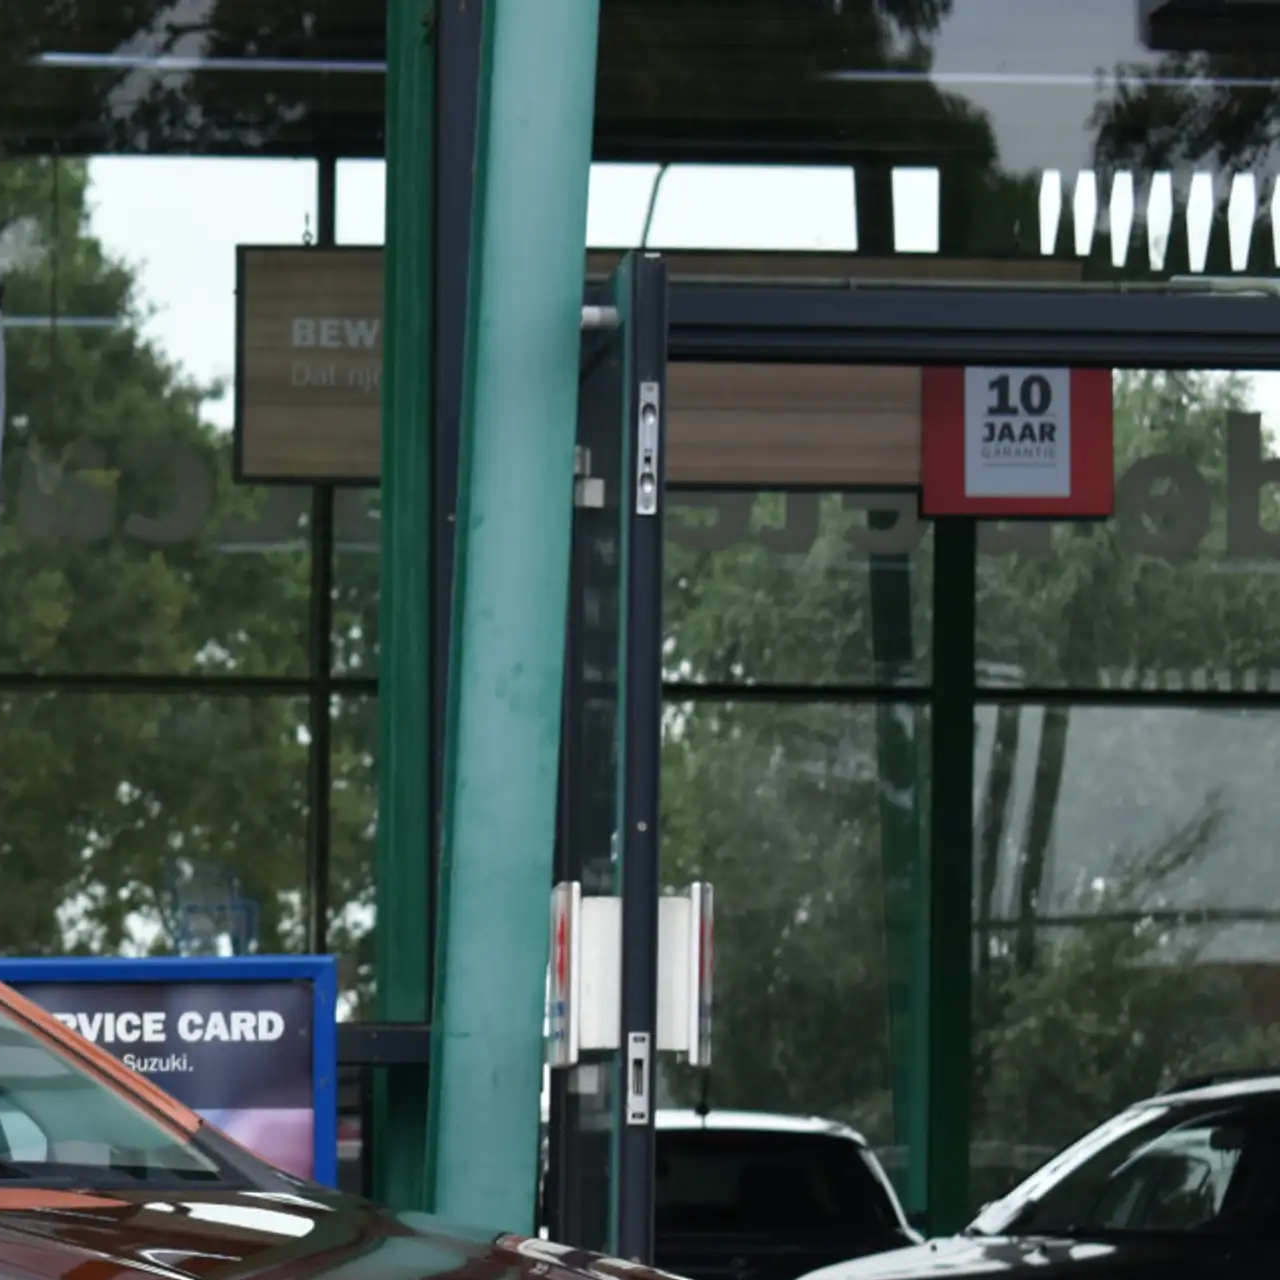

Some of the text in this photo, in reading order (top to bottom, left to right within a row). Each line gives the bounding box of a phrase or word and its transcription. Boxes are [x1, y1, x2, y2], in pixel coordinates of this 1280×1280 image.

[986, 372, 1053, 417] 10
[982, 421, 1057, 444] JAAR
[981, 445, 1057, 460] GARANTIE
[178, 1010, 285, 1043] CARD
[122, 1053, 195, 1073] Suzuki.
